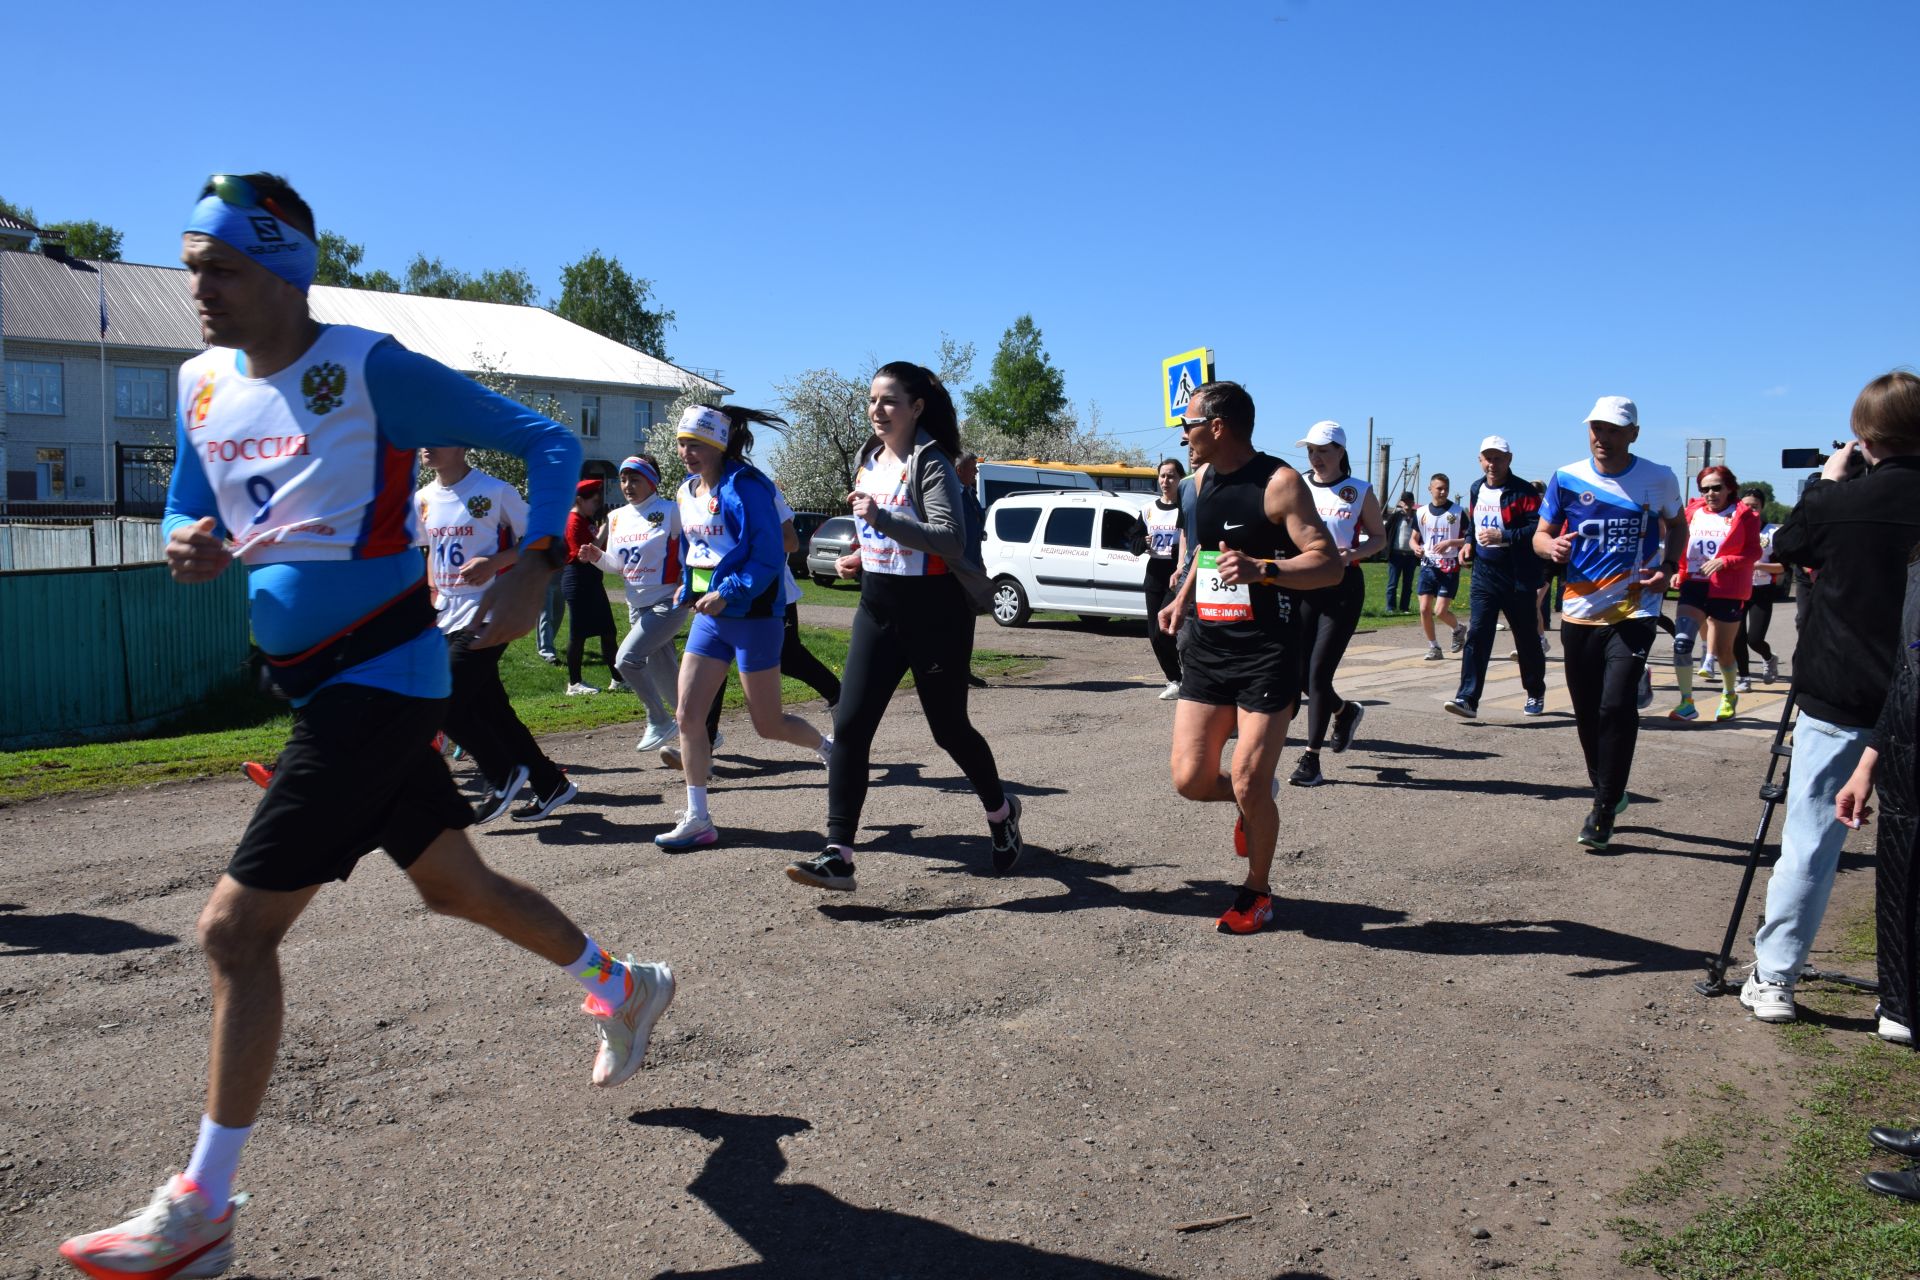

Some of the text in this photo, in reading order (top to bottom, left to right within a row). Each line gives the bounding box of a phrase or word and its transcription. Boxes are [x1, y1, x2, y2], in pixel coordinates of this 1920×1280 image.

[207, 434, 311, 462] РОССИЯ
[246, 475, 275, 525] 9
[1481, 515, 1499, 529] 44
[1608, 518, 1640, 526] ПРО
[1578, 519, 1604, 553] Я
[1608, 527, 1640, 535] СТО
[1155, 533, 1173, 547] 27
[1608, 536, 1638, 544] КОС
[1697, 540, 1716, 555] 19
[437, 543, 465, 567] 16
[618, 546, 642, 565] 25
[1040, 546, 1140, 562] МЕДИЦИНСКАЯ ПОМОЩЬ
